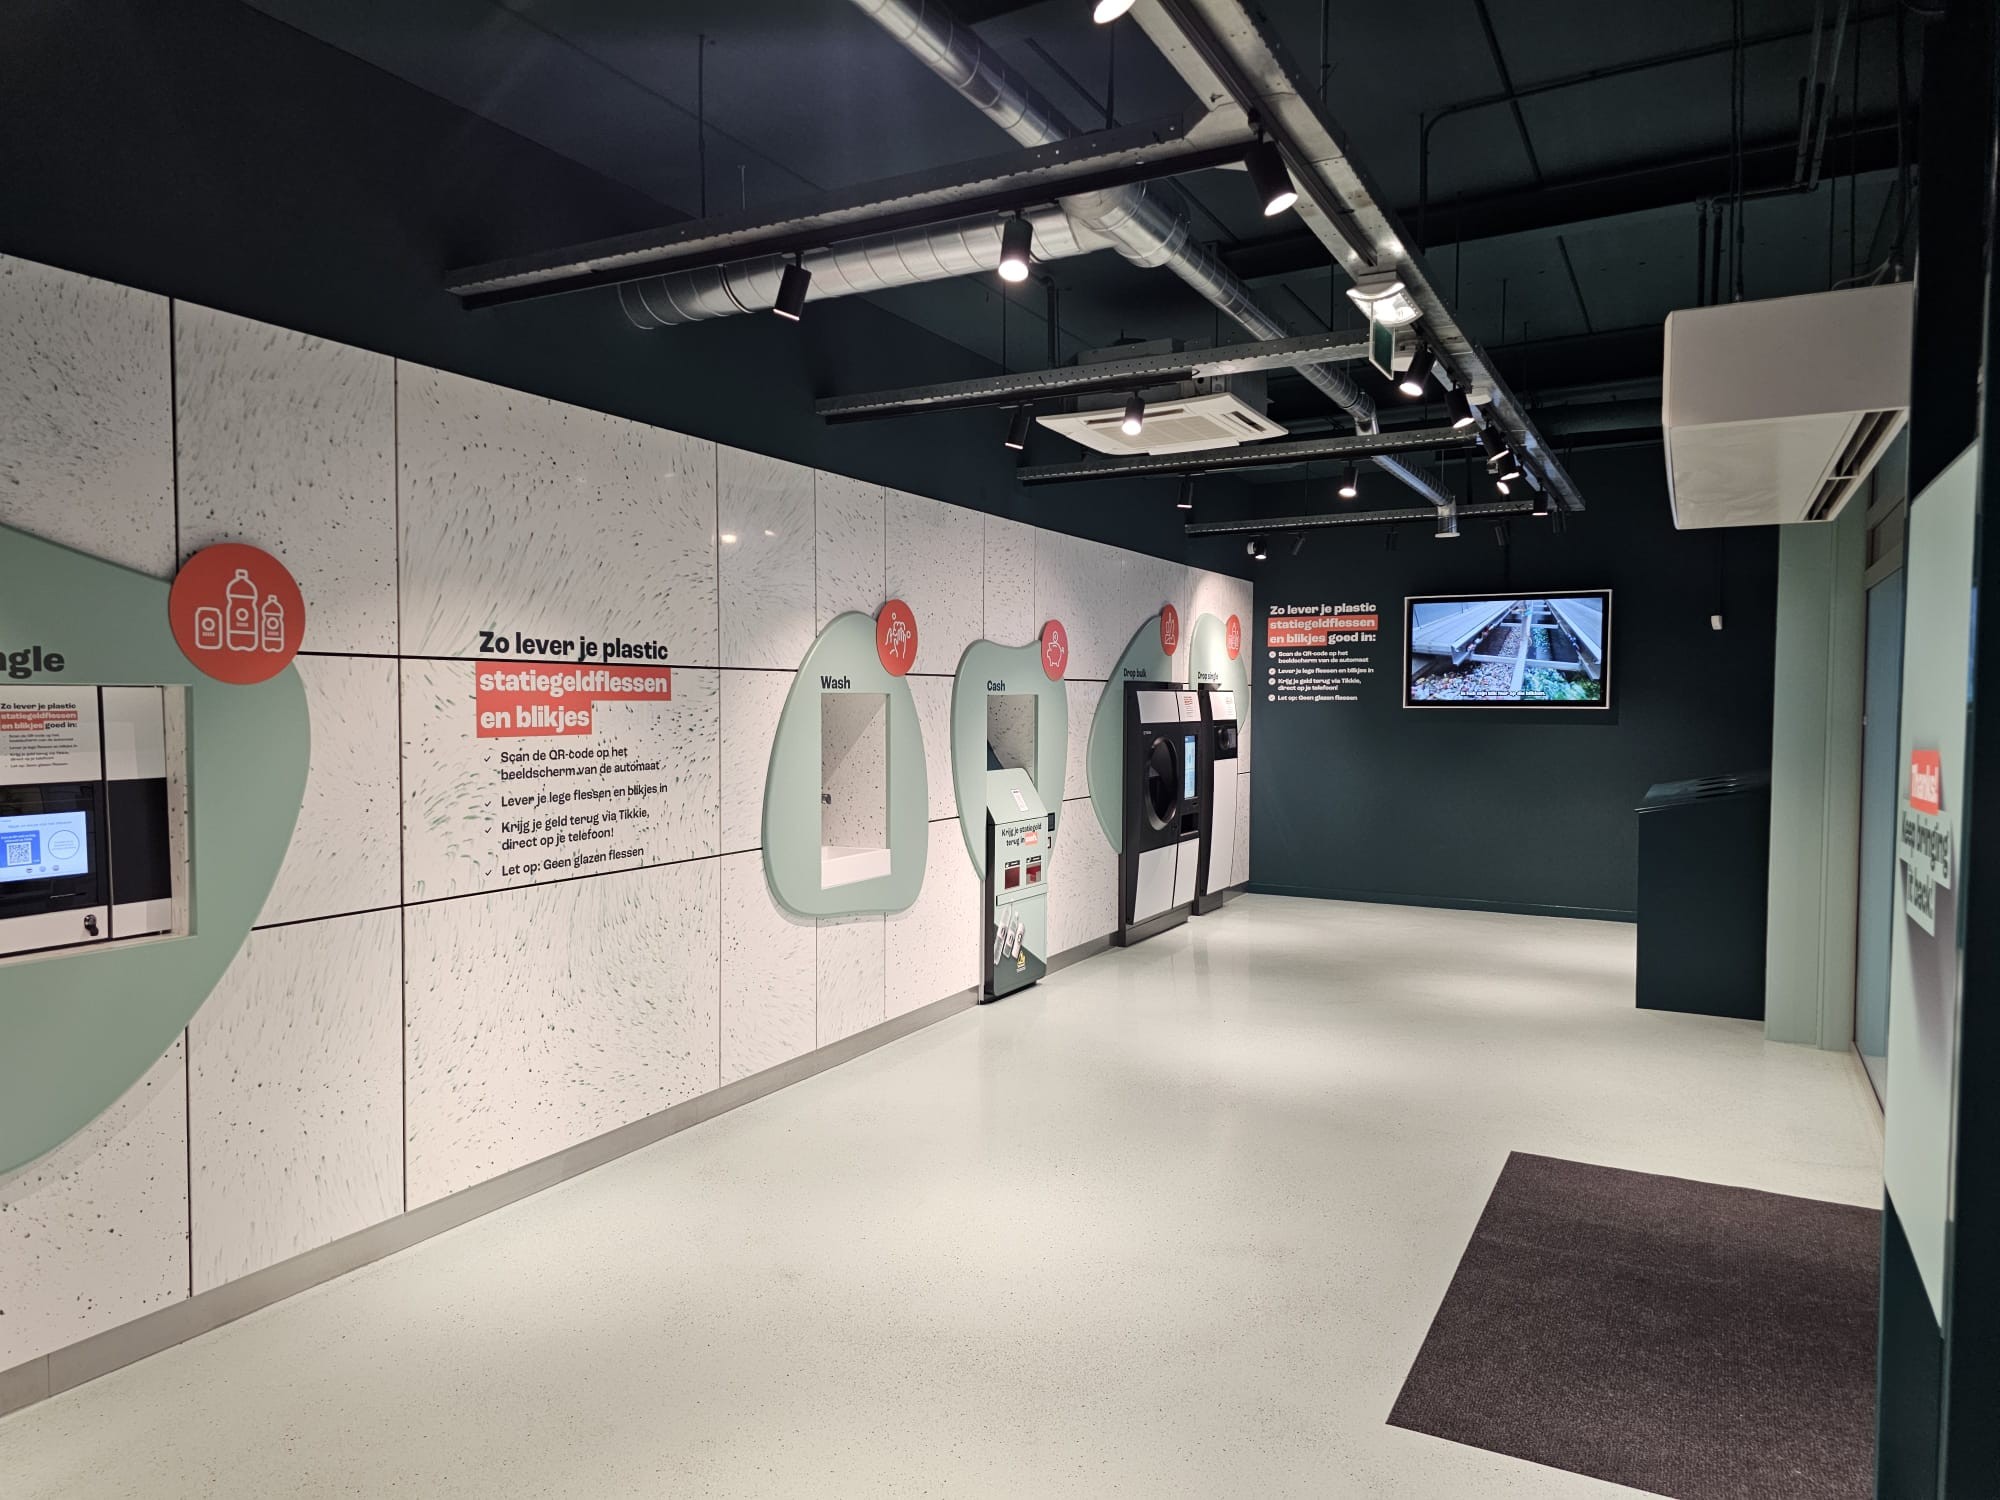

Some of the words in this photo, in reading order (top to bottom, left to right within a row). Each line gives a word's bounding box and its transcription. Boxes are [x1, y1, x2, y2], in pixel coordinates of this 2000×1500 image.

[1270, 606, 1285, 615] Zo
[1288, 604, 1318, 614] lever
[1320, 604, 1332, 615] je
[1334, 603, 1376, 615] plastic
[1270, 619, 1375, 630] statiegeldflessen
[1287, 633, 1326, 645] blikjes
[1328, 633, 1358, 645] goed
[1361, 632, 1376, 642] in:
[479, 631, 509, 653] Zo
[516, 632, 574, 656] lever
[579, 636, 597, 662] je
[603, 638, 668, 663] plastic
[1124, 669, 1136, 679] Drop
[1137, 669, 1146, 677] bulk
[1198, 672, 1207, 680] Drop
[1208, 672, 1219, 680] single
[480, 670, 667, 697] statiegeldflessen
[821, 676, 850, 689] Wash
[987, 680, 1005, 691] Cash
[1, 712, 76, 720] statiegeldflessen
[481, 710, 510, 728] en
[517, 705, 589, 733] blikjes
[501, 751, 529, 763] Scan
[533, 751, 546, 761] de
[549, 748, 593, 760] QR-code
[597, 749, 609, 761] op
[612, 747, 628, 757] het
[501, 767, 576, 780] beeldscherm
[578, 765, 597, 775] van
[600, 762, 612, 774] de
[614, 761, 659, 772] automaat
[501, 794, 534, 807] Lever
[535, 795, 546, 809] je
[550, 792, 571, 805] lege
[574, 788, 611, 801] flessen
[613, 787, 625, 796] en
[627, 784, 657, 799] blikjes
[659, 783, 667, 793] in
[501, 821, 530, 834] Krijg
[532, 820, 542, 832] je
[545, 816, 567, 830] geld
[570, 814, 599, 828] terug
[602, 811, 616, 821] via
[619, 808, 649, 820] Tikkie,
[1002, 827, 1014, 837] Krijg
[1014, 827, 1018, 837] je
[1020, 823, 1041, 832] statiegeld
[502, 836, 537, 850] direct
[540, 836, 553, 847] op
[556, 833, 565, 845] je
[568, 828, 613, 843] telefoon!
[1007, 838, 1019, 846] terug
[1917, 815, 1948, 878] bringing
[502, 865, 520, 877] Let
[523, 863, 540, 875] op:
[544, 857, 571, 870] Geen
[574, 853, 606, 868] glazen
[609, 847, 644, 861] flessen
